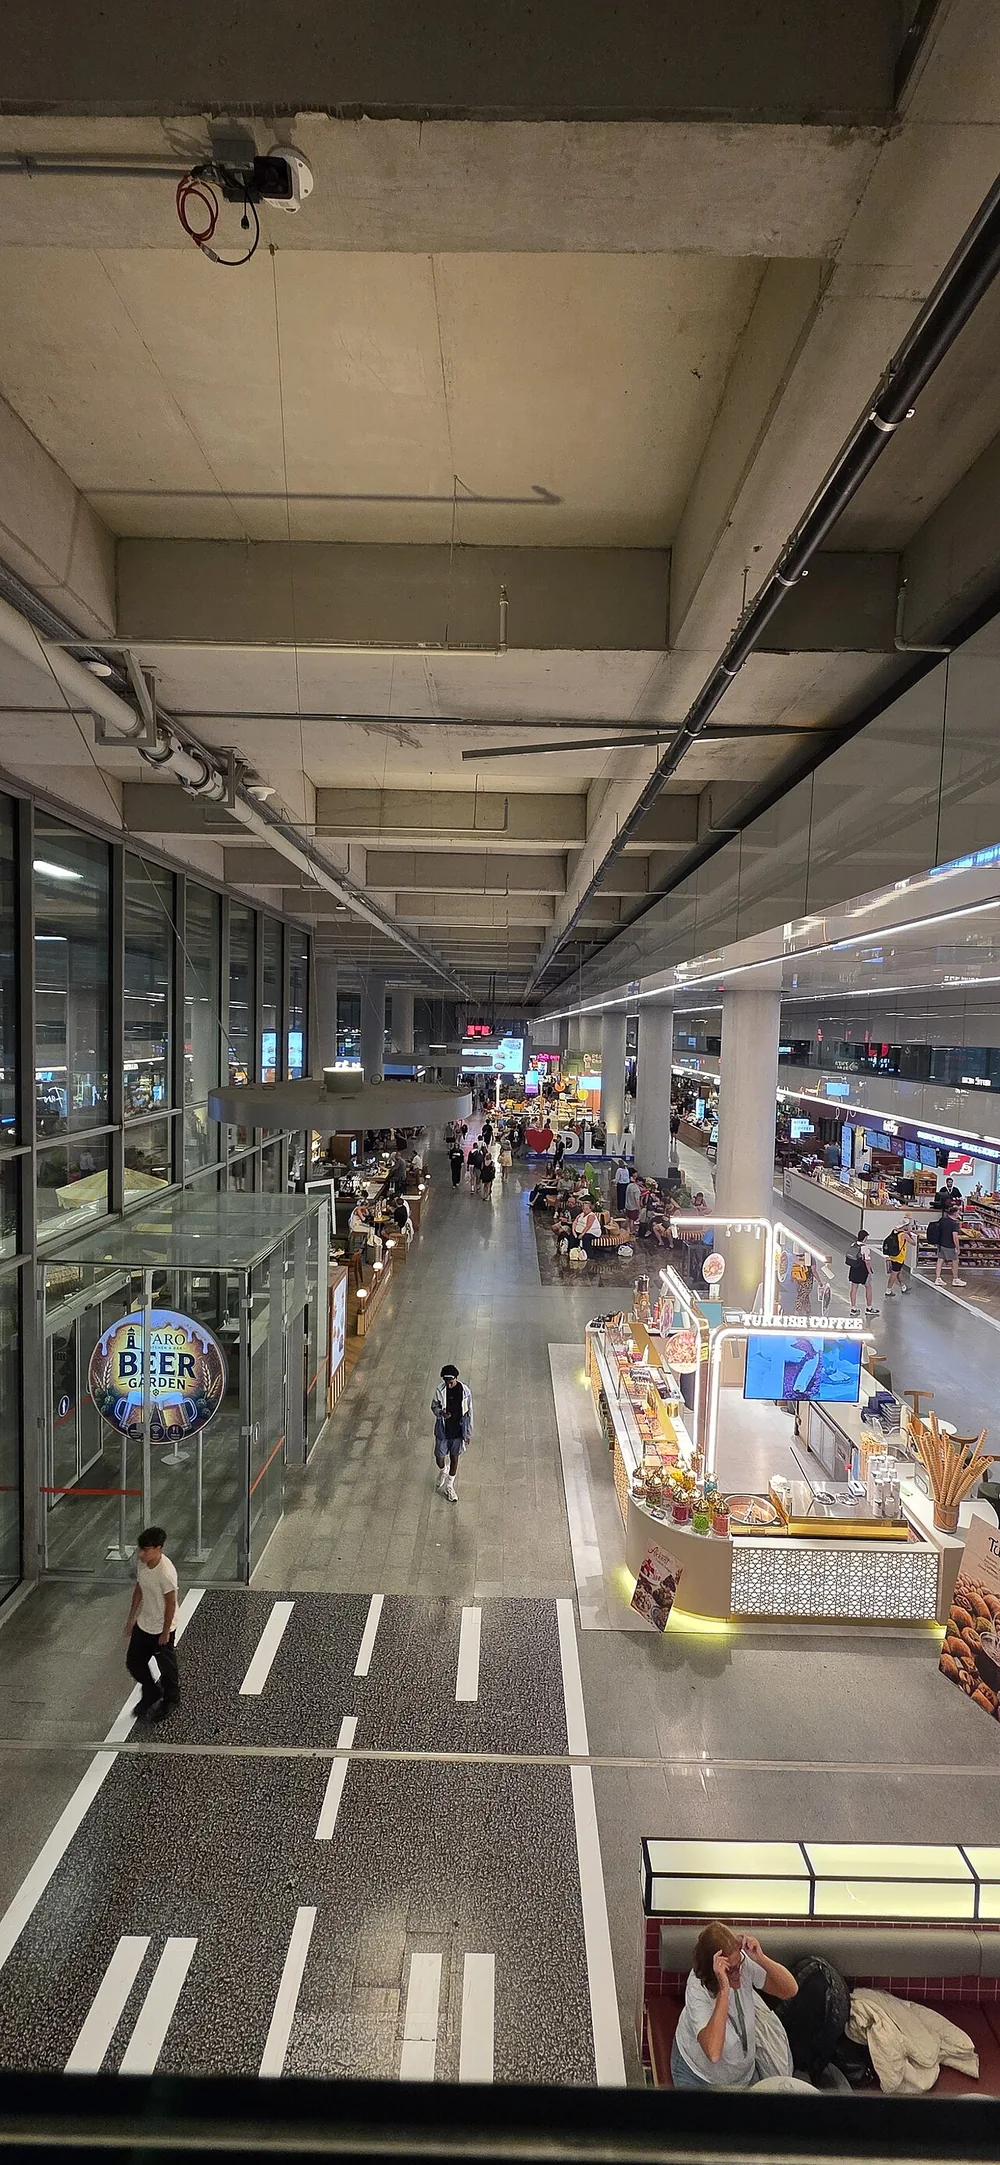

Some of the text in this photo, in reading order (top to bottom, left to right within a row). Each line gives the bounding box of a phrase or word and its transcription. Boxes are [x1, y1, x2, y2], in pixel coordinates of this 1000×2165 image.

[548, 1130, 635, 1156] DLM
[741, 1313, 863, 1330] TURKISH COFFEE
[150, 1333, 186, 1346] ARO
[118, 1351, 196, 1379] BEER
[128, 1377, 186, 1390] GARDEN
